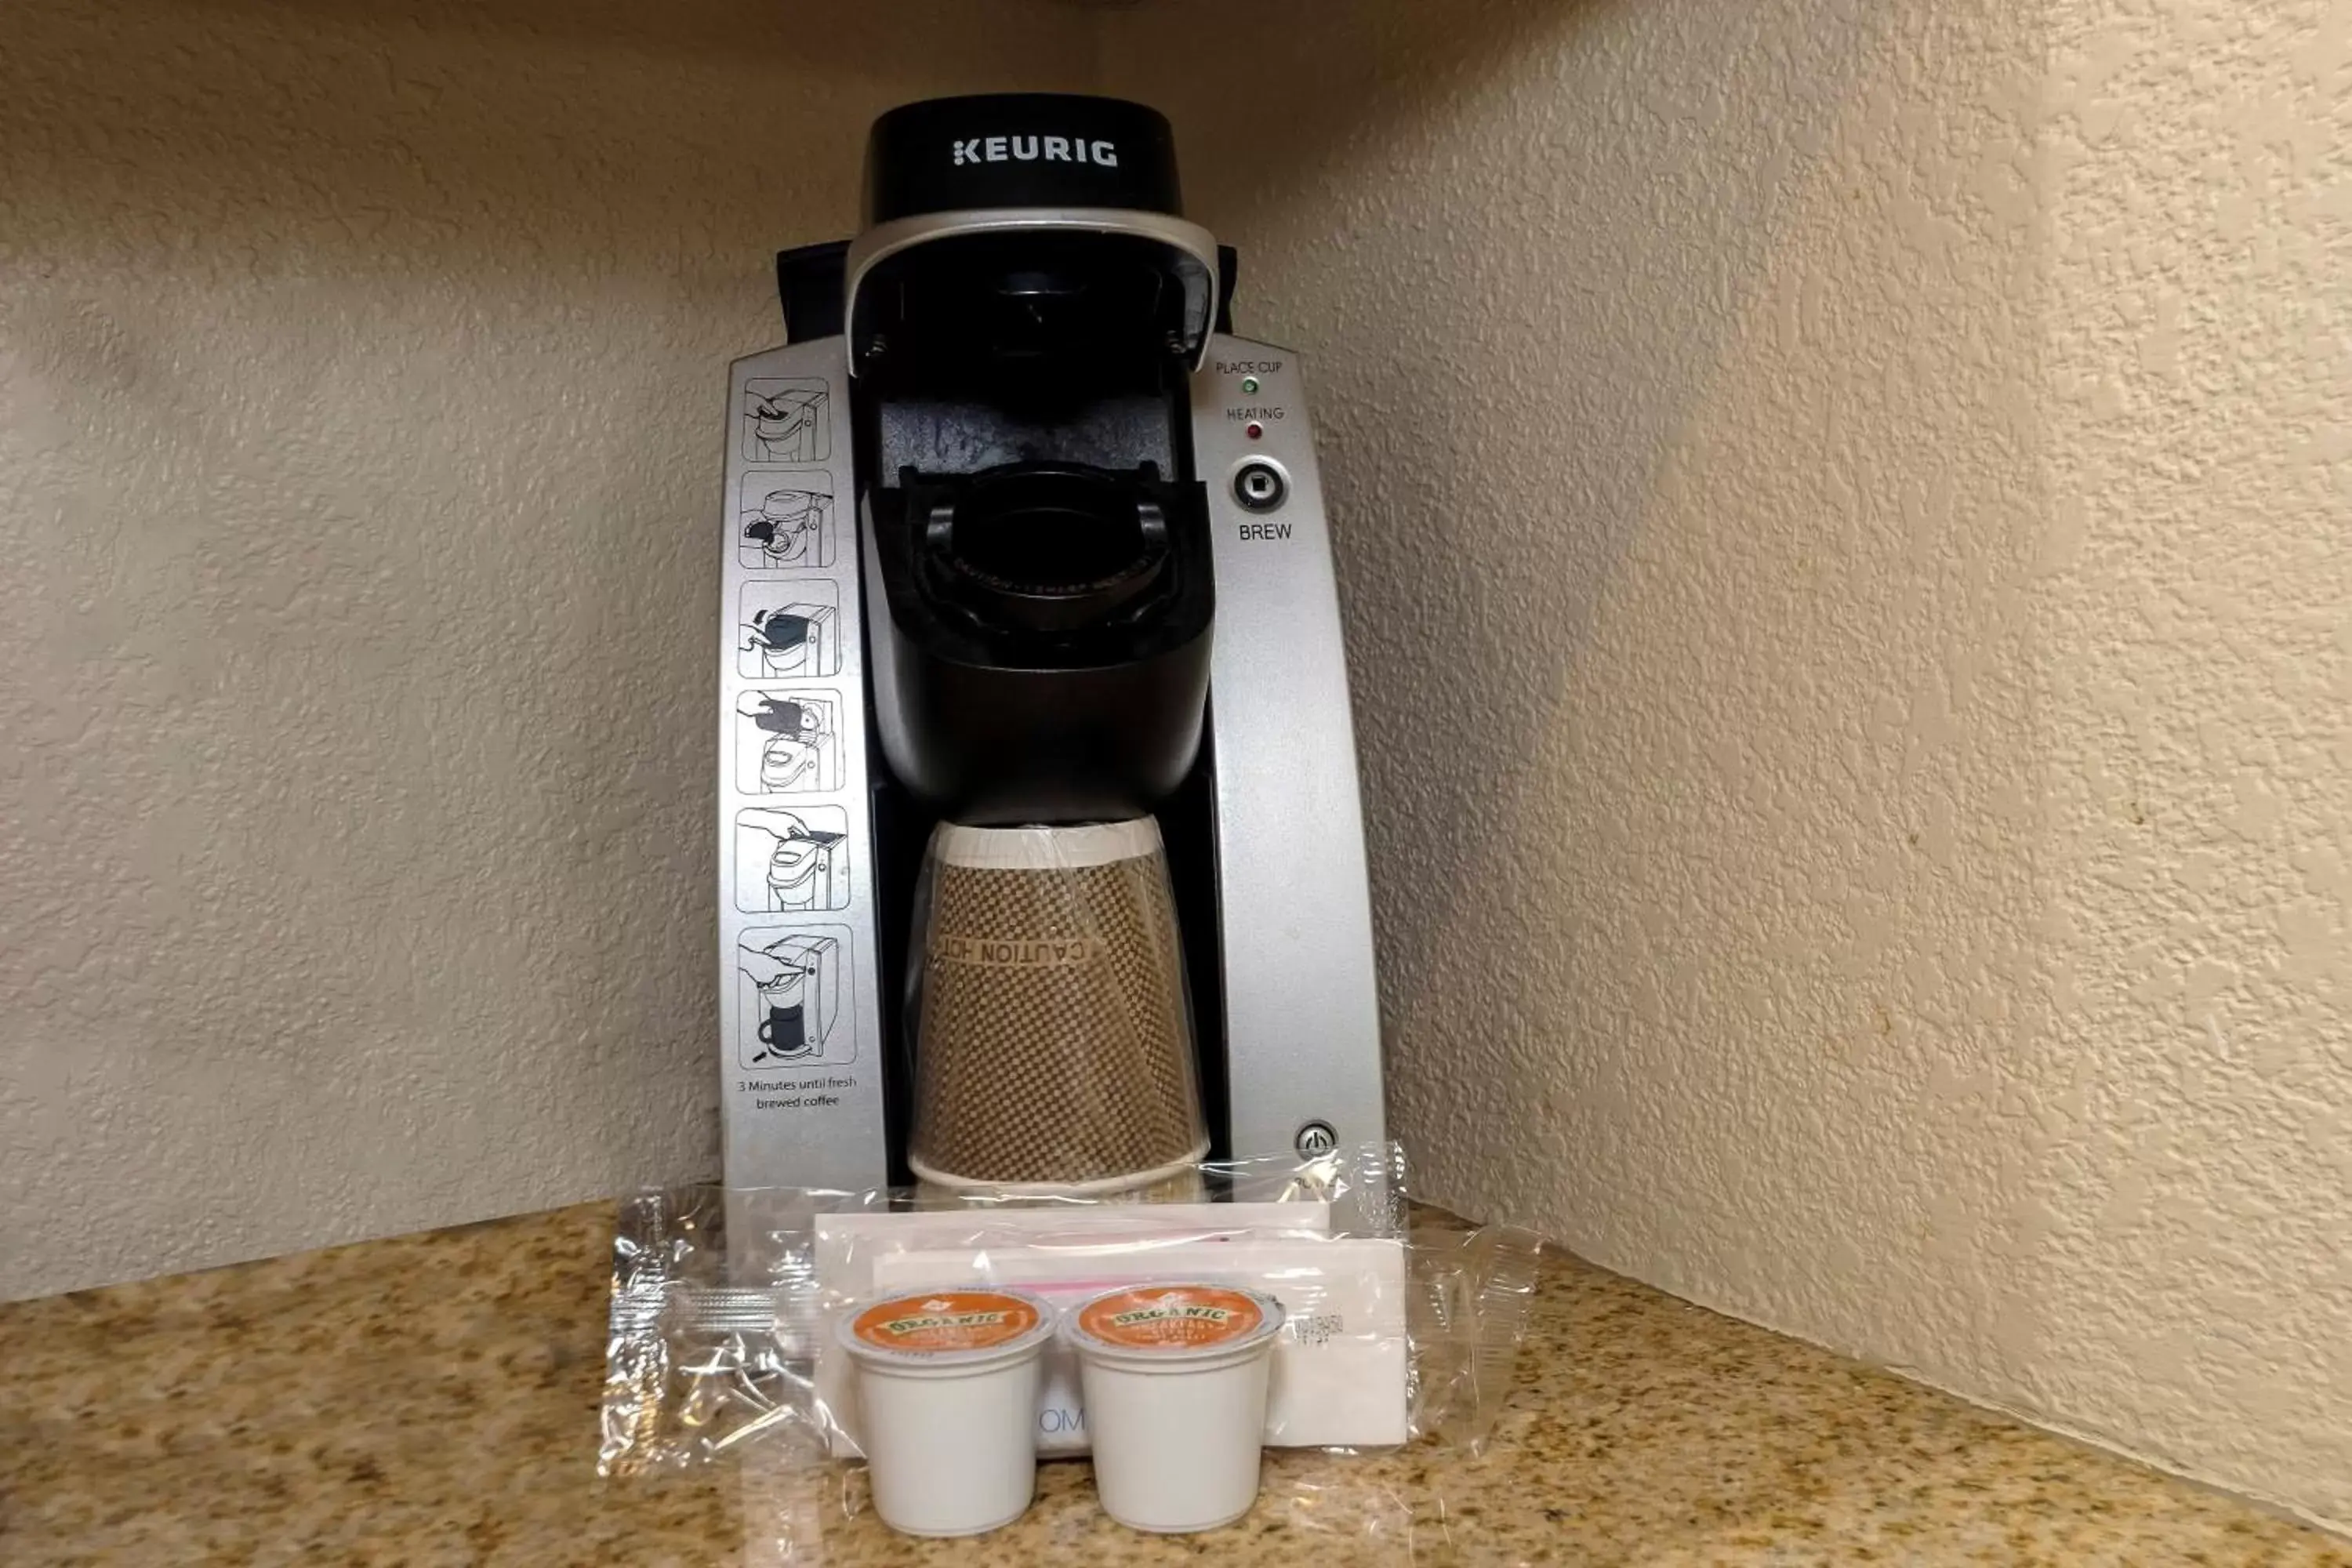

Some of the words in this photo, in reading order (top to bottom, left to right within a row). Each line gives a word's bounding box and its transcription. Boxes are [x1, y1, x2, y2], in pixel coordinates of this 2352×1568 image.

[953, 136, 1118, 167] KEURIG
[1216, 361, 1254, 374] PLACE
[1258, 361, 1283, 374] CUP
[1227, 407, 1284, 420] HEATING
[1240, 524, 1292, 540] BREW
[981, 942, 1085, 964] CAUTION
[738, 1081, 746, 1091] 3
[749, 1080, 796, 1092] Minutes
[799, 1078, 826, 1089] until
[828, 1076, 857, 1088] fresh
[757, 1097, 800, 1109] brewed
[804, 1094, 840, 1107] coffee
[1116, 1307, 1226, 1323] ORGANIC
